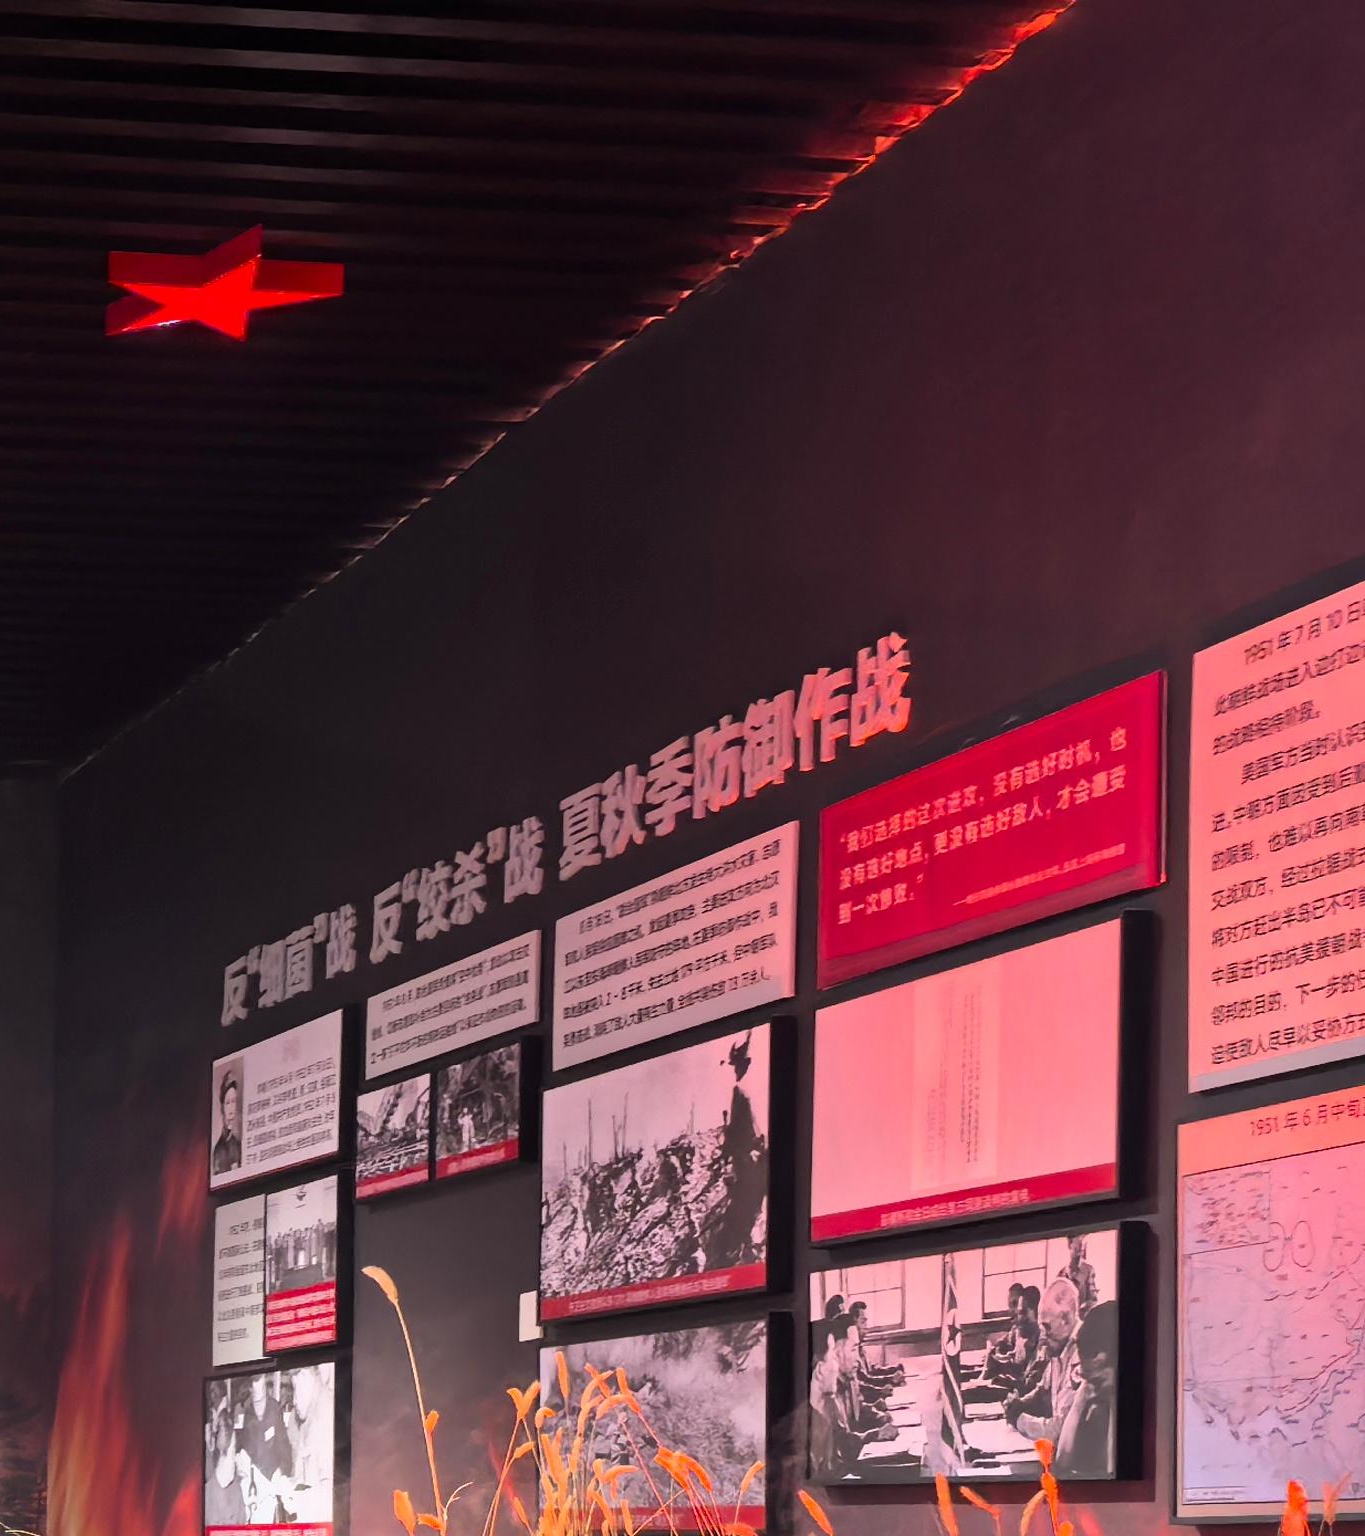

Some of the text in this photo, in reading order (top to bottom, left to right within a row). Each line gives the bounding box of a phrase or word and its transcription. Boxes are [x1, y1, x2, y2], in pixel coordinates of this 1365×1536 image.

[1244, 598, 1365, 665] 1951年7月10日
[558, 632, 911, 881] 夏秋季防御作战
[1212, 928, 1365, 986] 中国进行的抗美援朝战
[1250, 1096, 1365, 1136] 1951年6月中旬
